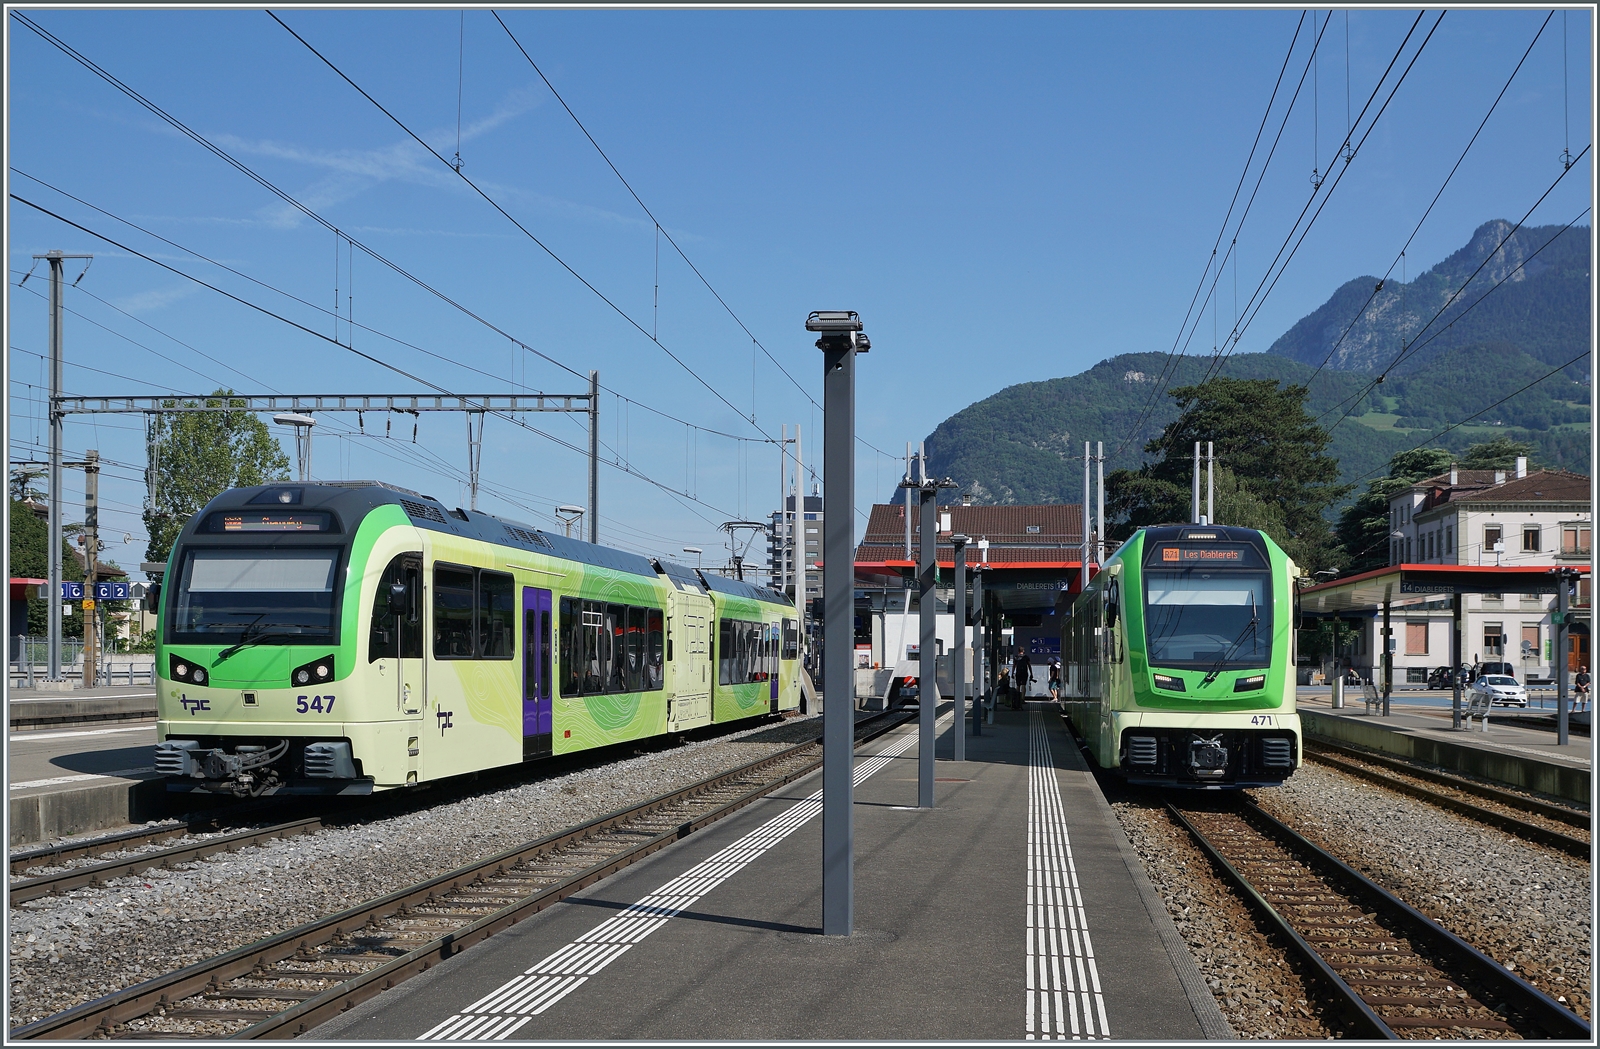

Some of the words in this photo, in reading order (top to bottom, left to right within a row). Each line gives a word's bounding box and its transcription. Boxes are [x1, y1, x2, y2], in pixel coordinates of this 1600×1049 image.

[1184, 550, 1198, 559] Les
[1200, 550, 1238, 559] Diablerets
[904, 580, 914, 588] 12
[1016, 582, 1055, 590] DIABLERETS
[1056, 581, 1066, 589] 13
[1403, 584, 1412, 592] 14
[1414, 585, 1455, 593] DIABLERETS
[72, 587, 81, 597] C
[100, 587, 108, 597] C
[116, 587, 124, 597] 2
[180, 693, 212, 716] tpc
[296, 695, 336, 714] 547
[1251, 715, 1272, 726] 471
